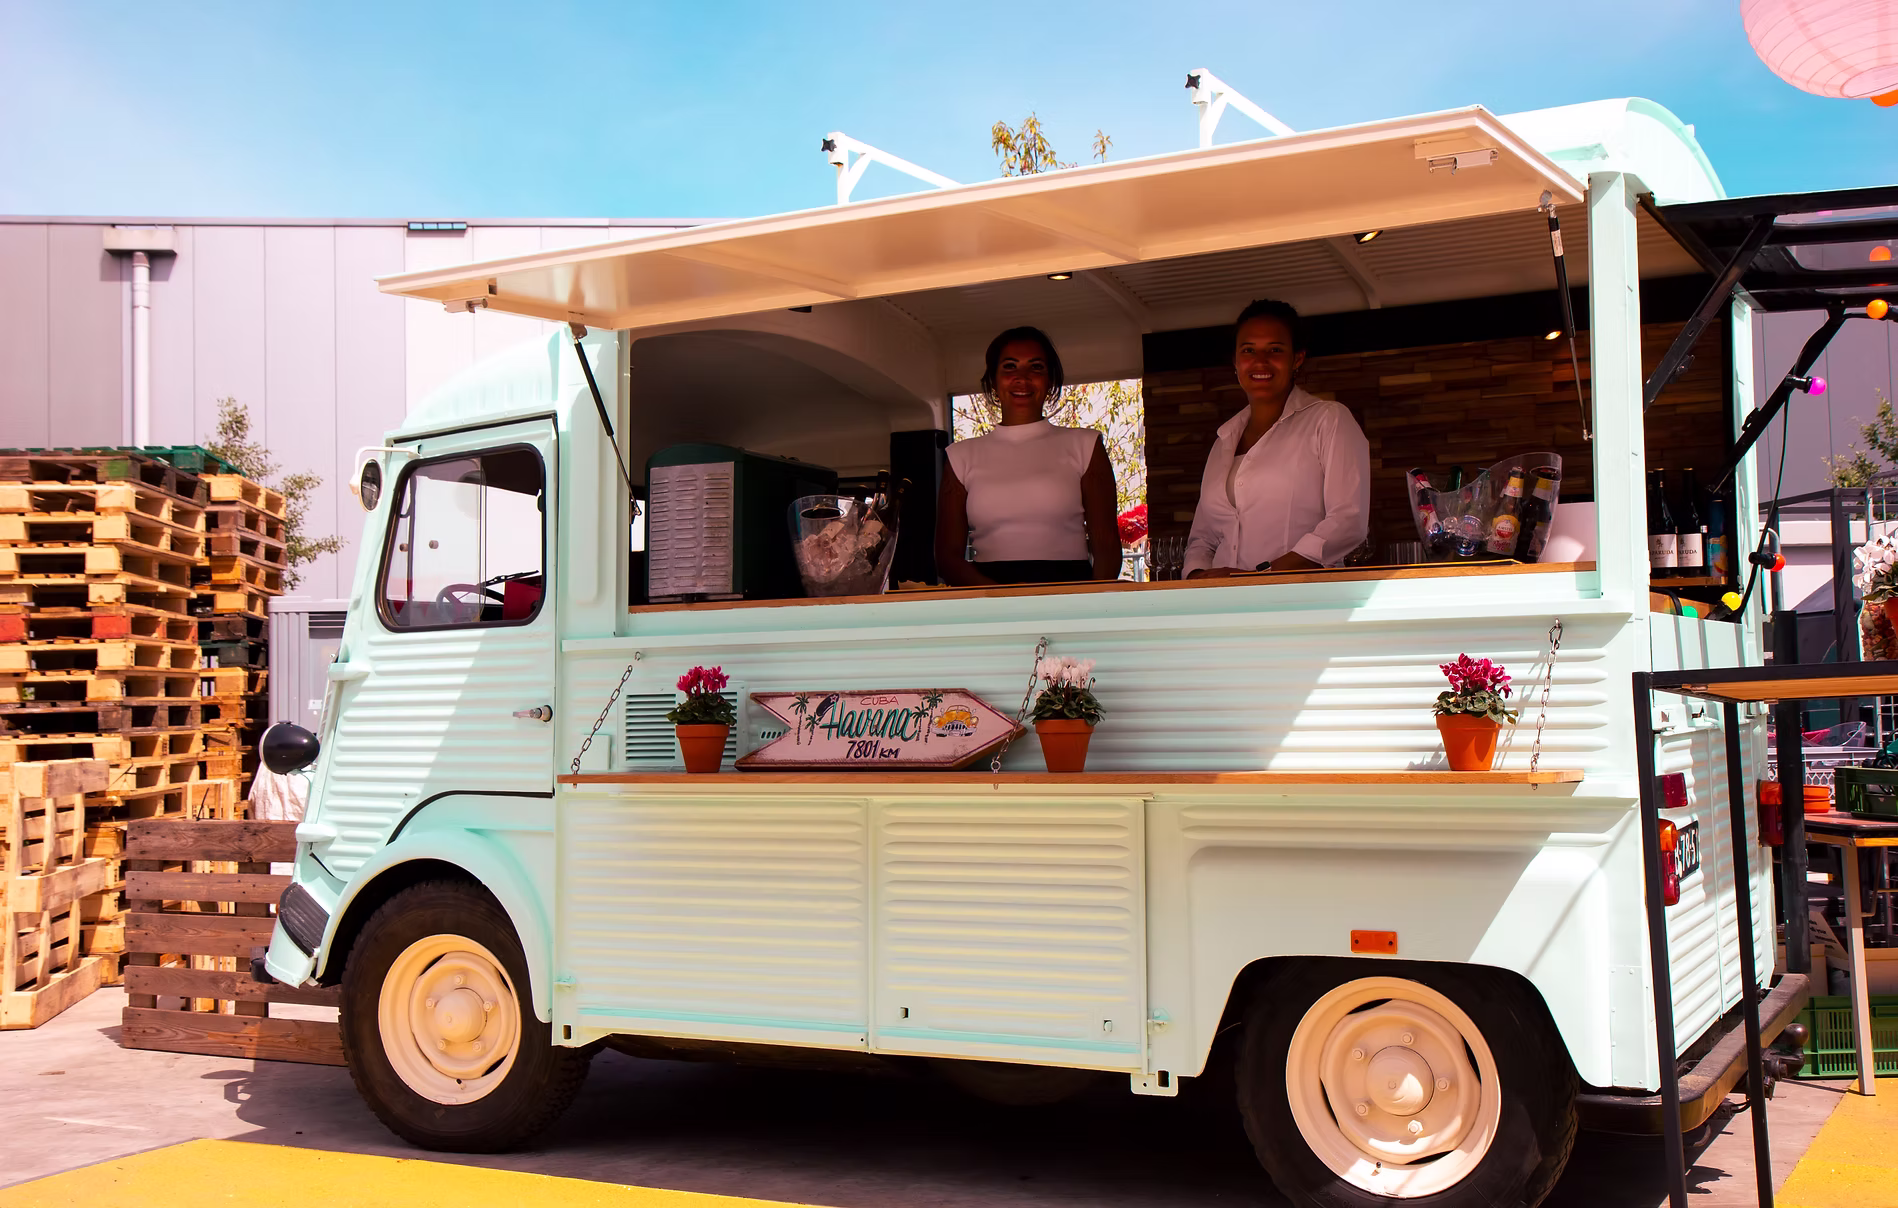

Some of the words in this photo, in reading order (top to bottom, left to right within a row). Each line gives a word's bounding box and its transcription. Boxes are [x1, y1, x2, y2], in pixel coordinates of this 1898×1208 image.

[860, 696, 899, 706] CUBA
[819, 699, 918, 742] Havana
[846, 740, 880, 759] 7801
